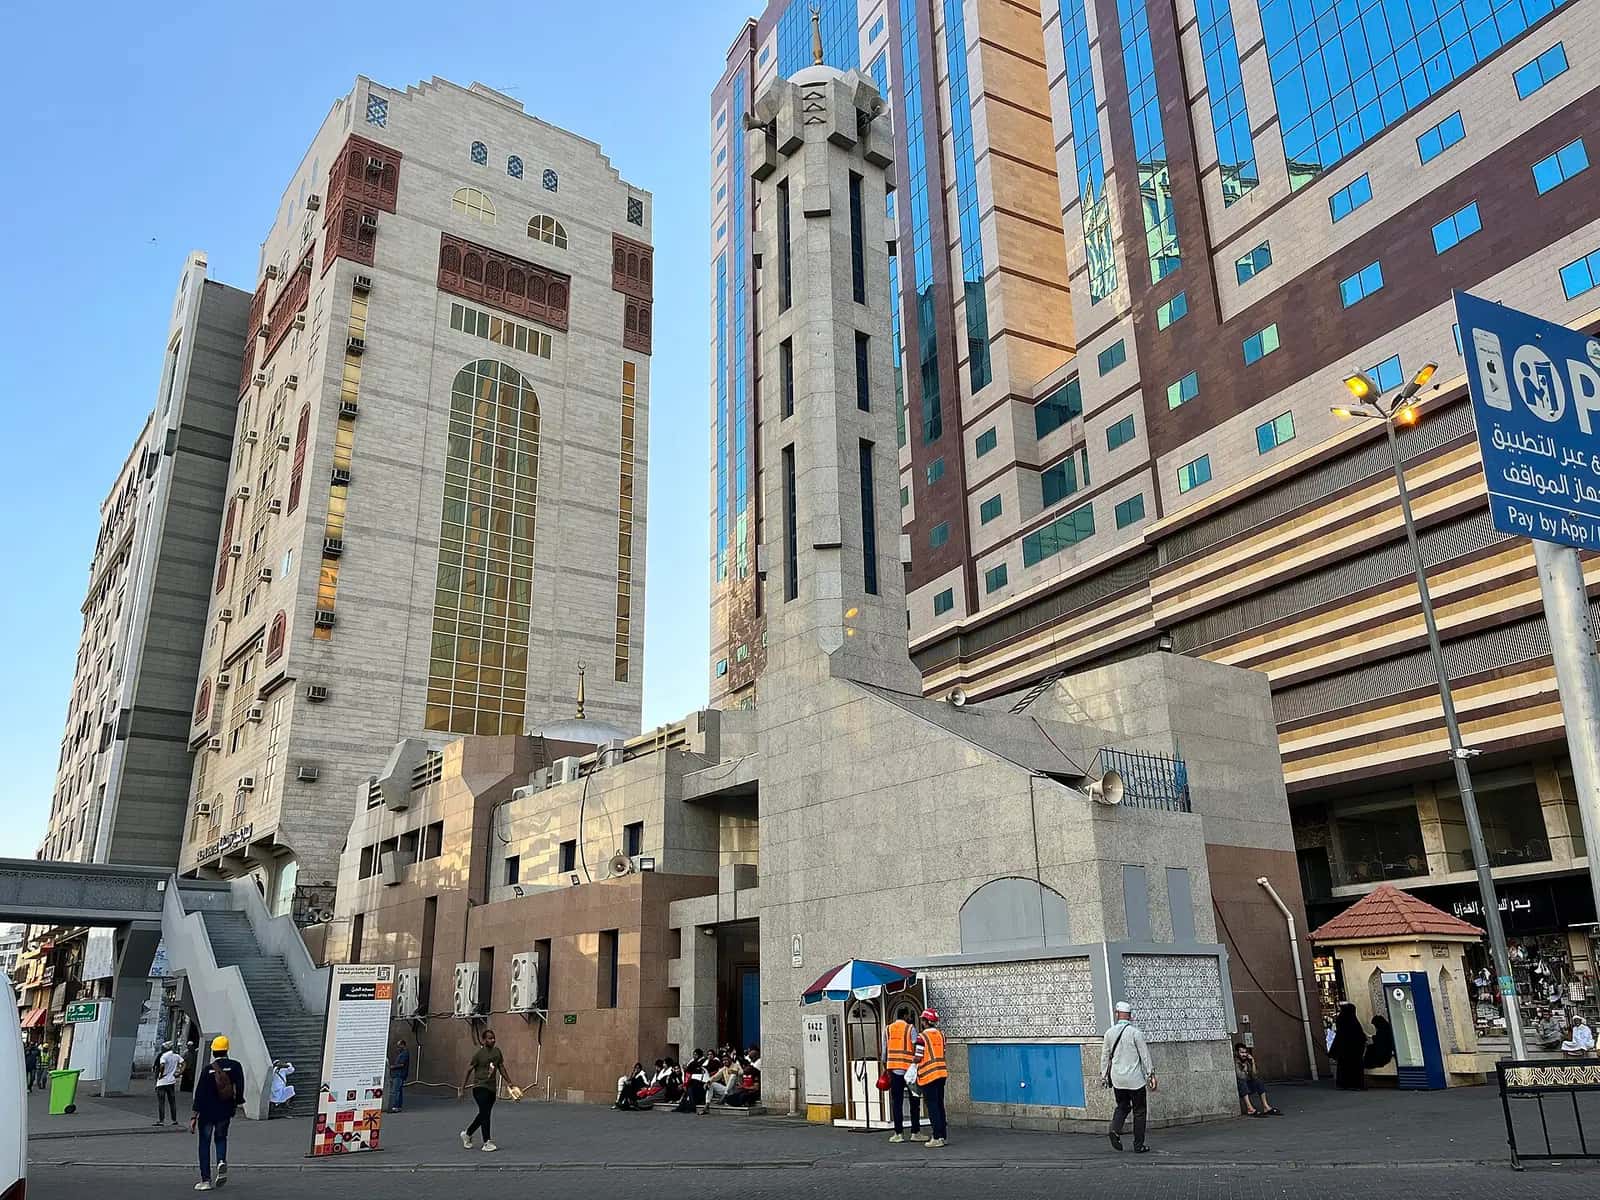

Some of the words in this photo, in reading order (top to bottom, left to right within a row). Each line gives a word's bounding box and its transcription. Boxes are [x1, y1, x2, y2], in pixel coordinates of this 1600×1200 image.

[1566, 358, 1600, 435] P
[1492, 423, 1557, 459] التطبيق
[1561, 447, 1587, 469] عبر
[1503, 462, 1570, 496] المواقف
[1573, 477, 1600, 503] هاز
[1508, 506, 1533, 532] Pay
[1539, 512, 1557, 537] by
[1561, 518, 1588, 543] App
